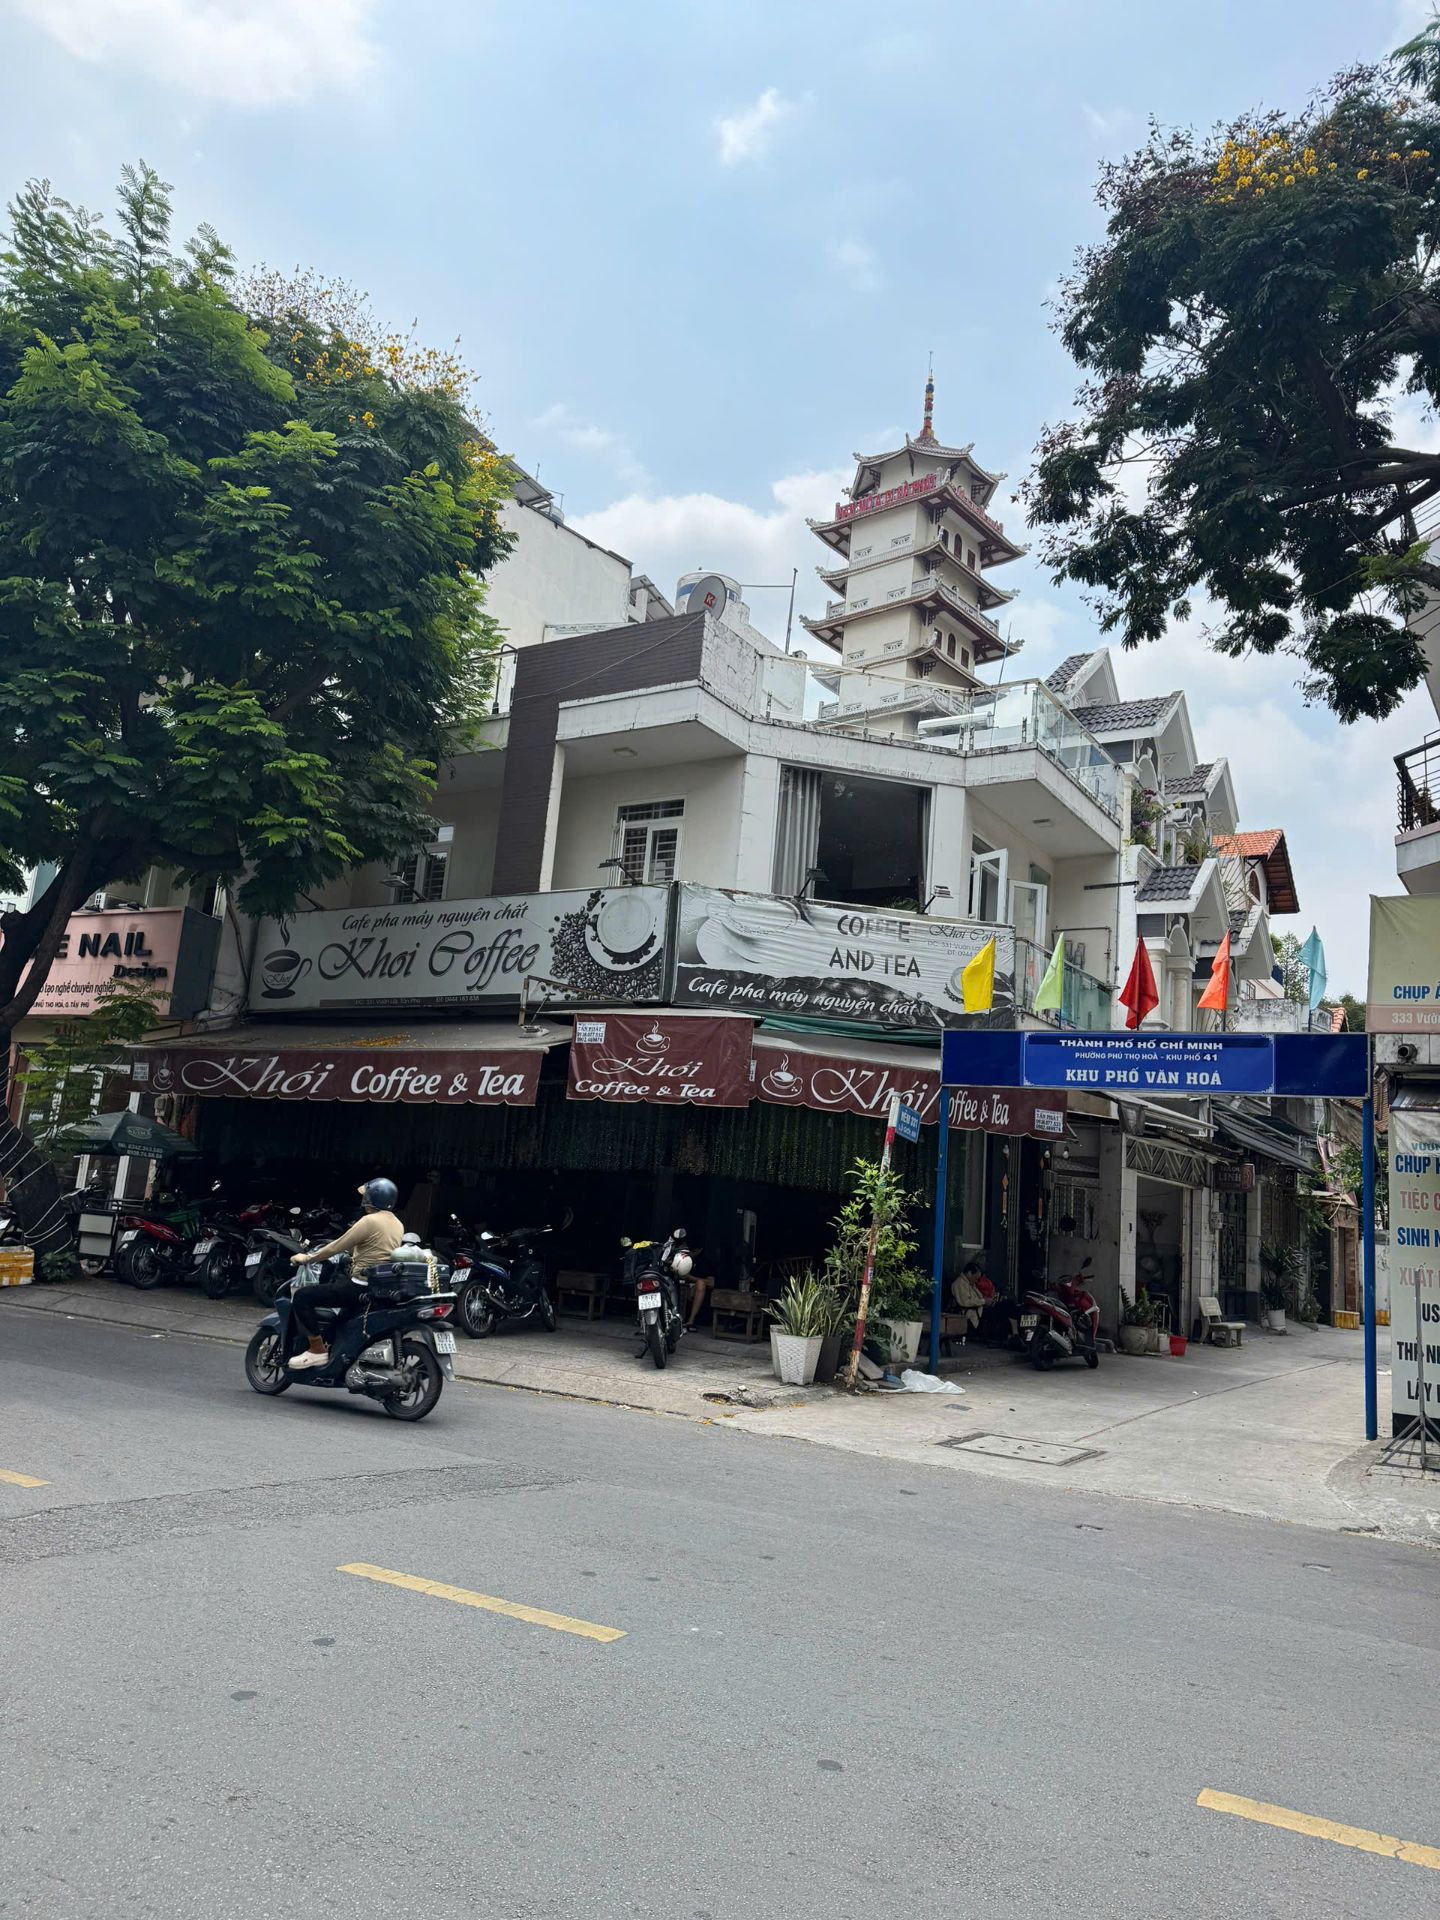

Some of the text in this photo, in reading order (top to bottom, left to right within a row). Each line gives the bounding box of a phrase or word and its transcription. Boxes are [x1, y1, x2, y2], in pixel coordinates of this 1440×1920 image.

[342, 902, 529, 933] Cafe pha máy nguyên chất
[837, 914, 911, 943] COFFEE
[78, 932, 152, 959] NAIL
[428, 928, 541, 991] Coffee
[829, 947, 921, 978] AND TEA
[71, 981, 94, 996] chuyên
[688, 976, 918, 1015] Cafe pha máy nguyên chất
[1393, 985, 1431, 1002] CHỤP
[1392, 1012, 1413, 1024] 333
[1059, 1037, 1103, 1048] THÀNH
[1108, 1038, 1135, 1049] PHỐ
[1159, 1039, 1184, 1049] CHÍ
[1187, 1041, 1223, 1050] MINH
[592, 1057, 703, 1078] Khói
[1075, 1051, 1106, 1060] PHƯỜNG
[1107, 1051, 1123, 1060] PHÚ
[1124, 1053, 1140, 1061] THỌ
[1184, 1053, 1201, 1061] PHỐ
[1203, 1054, 1218, 1062] 41
[181, 1055, 334, 1094] Khói
[350, 1065, 442, 1100] Coffee
[447, 1073, 469, 1096] &
[477, 1066, 526, 1096] Tea
[1066, 1069, 1099, 1082] KHU
[1105, 1067, 1140, 1083] PHỐ
[1145, 1069, 1179, 1085] VĂN
[575, 1080, 717, 1098] Coffee & Tea
[948, 1090, 977, 1126] offee
[980, 1102, 989, 1124] &
[992, 1093, 1010, 1126] Tea
[1395, 1154, 1431, 1178] CHỤP
[1400, 1188, 1429, 1214] TIỆC
[1397, 1227, 1430, 1248] SINH
